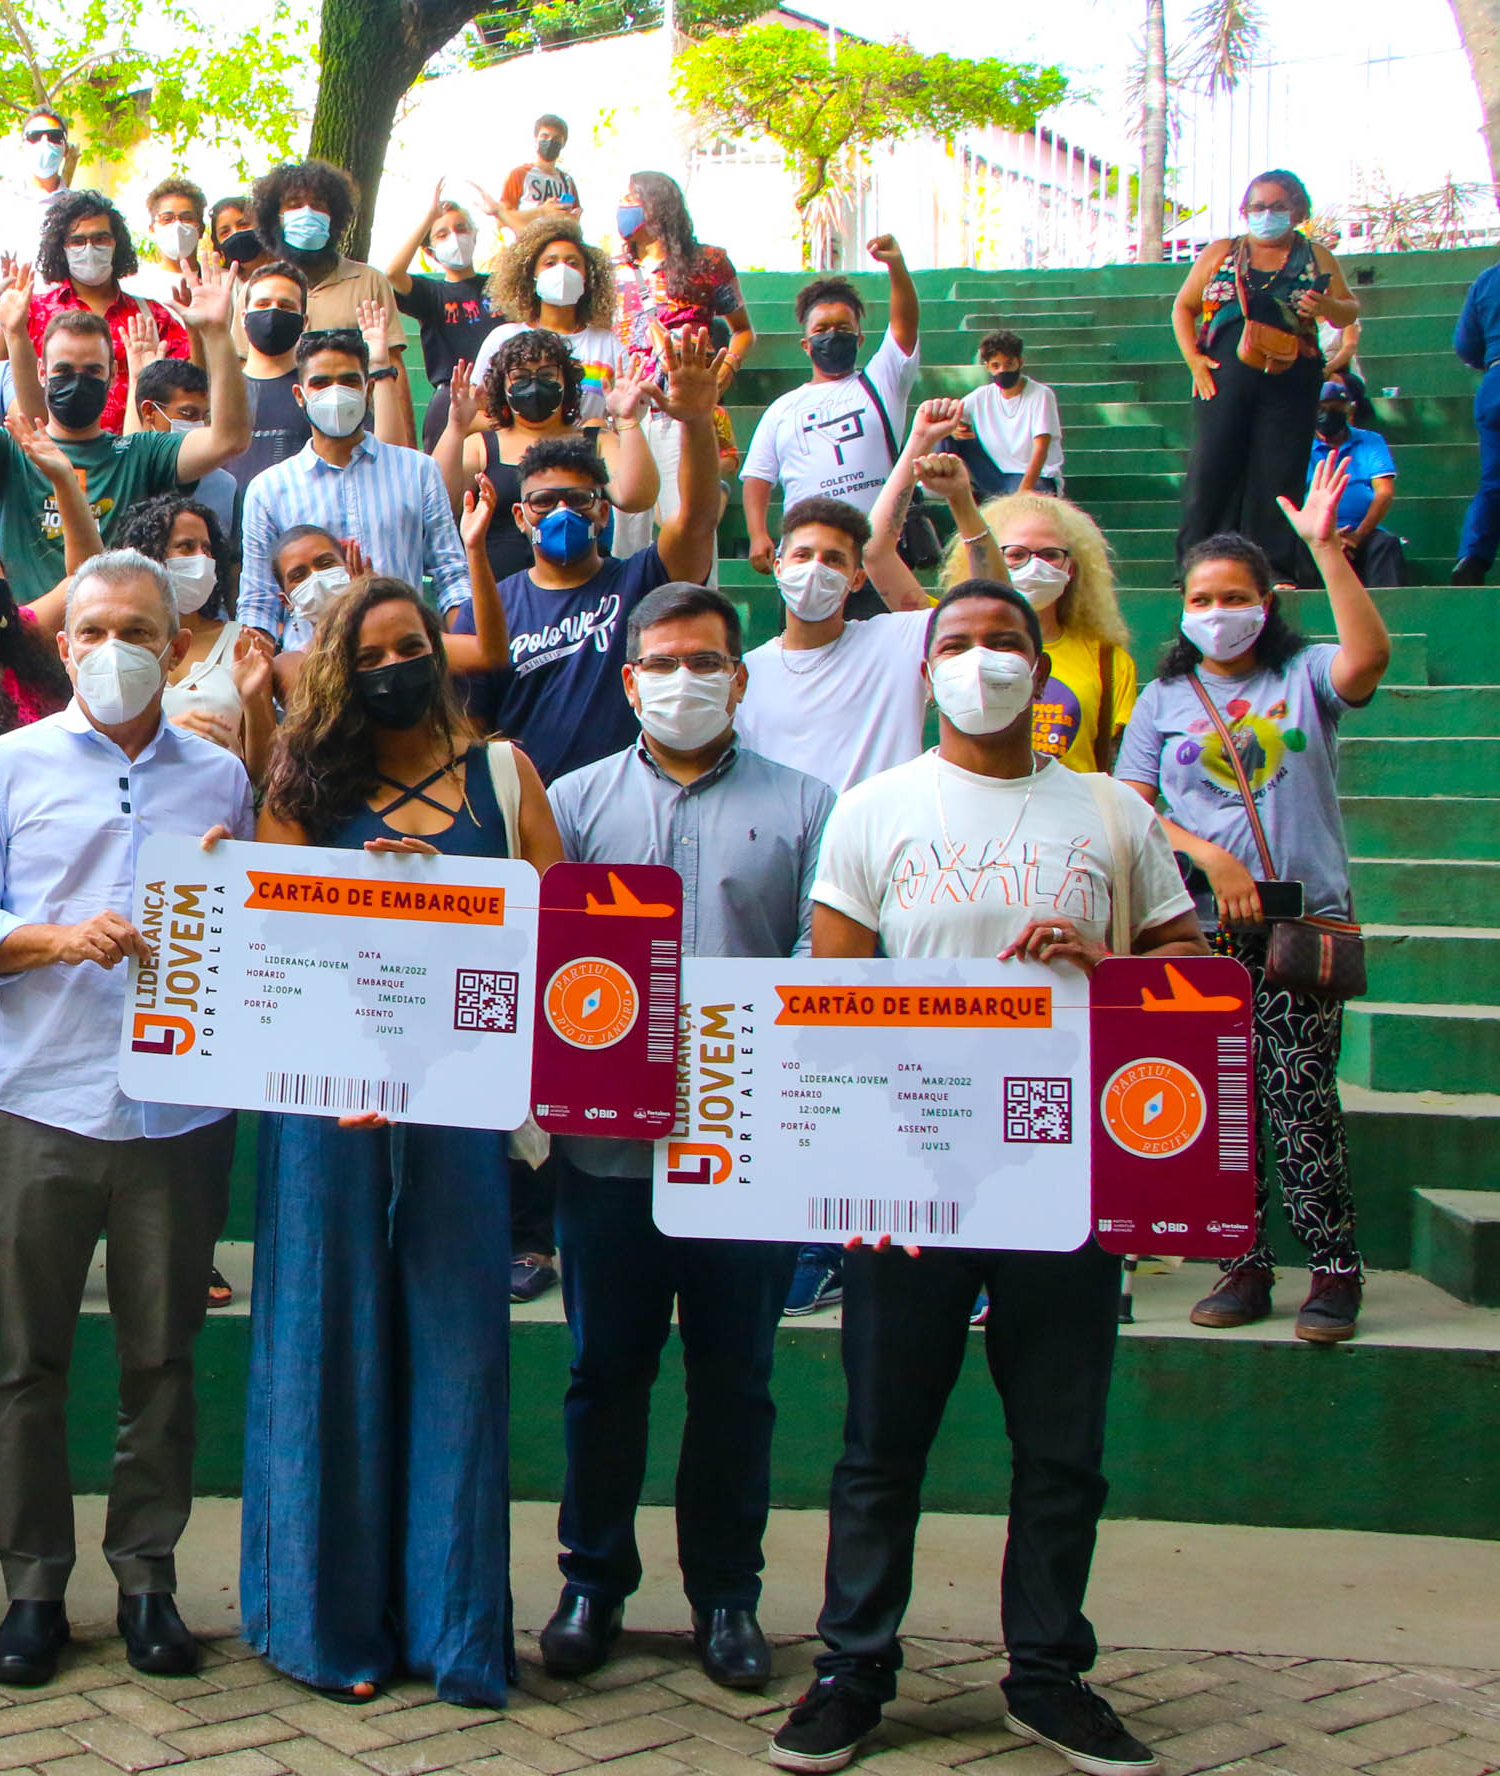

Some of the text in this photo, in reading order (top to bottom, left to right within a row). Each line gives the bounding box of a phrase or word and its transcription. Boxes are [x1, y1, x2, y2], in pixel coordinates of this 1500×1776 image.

[820, 471, 865, 488] COLETIVO
[832, 487, 846, 496] DA
[509, 626, 562, 663] Polo
[258, 882, 499, 917] CARTÃO DE EMBARQUE
[165, 884, 207, 1012] JOVEM
[248, 943, 266, 951] VOO
[358, 951, 381, 960] DATA
[264, 956, 349, 970] LIDERANÇA JOVEM
[201, 885, 225, 1056] FORTALEZA
[246, 968, 285, 979] HORÁRIO
[380, 964, 427, 976] MAR/2022
[356, 978, 405, 989] EMBARQUE
[263, 985, 302, 996] 12:00PM
[244, 999, 278, 1010] PORTÃO
[378, 994, 426, 1005] IMEDIATO
[788, 992, 1046, 1020] CARTÃO DE EMBARQUE
[355, 1009, 393, 1018] ASSENTO
[260, 1016, 272, 1024] 55
[556, 999, 633, 1044] RIO DE JANEIRO
[375, 1025, 404, 1035] JUV13
[698, 1003, 735, 1139] JOVEM
[781, 1062, 800, 1070] VOO
[897, 1063, 922, 1072] DATA
[799, 1075, 888, 1086] LIDERANÇA JOVEM
[922, 1076, 972, 1086] MAR/2022
[739, 1003, 754, 1184] FORTALEZA
[781, 1088, 822, 1098] HORÁRIO
[897, 1092, 949, 1102] EMBARQUE
[599, 1109, 618, 1119] BID
[799, 1105, 841, 1115] 12:00PM
[921, 1108, 973, 1118] IMEDIATO
[781, 1121, 816, 1131] PORTÃO
[897, 1125, 939, 1134] ASSENTO
[798, 1139, 811, 1147] 55
[920, 1141, 950, 1151] JUV13
[1141, 1130, 1190, 1153] RECIFE
[1167, 1222, 1189, 1233] BID
